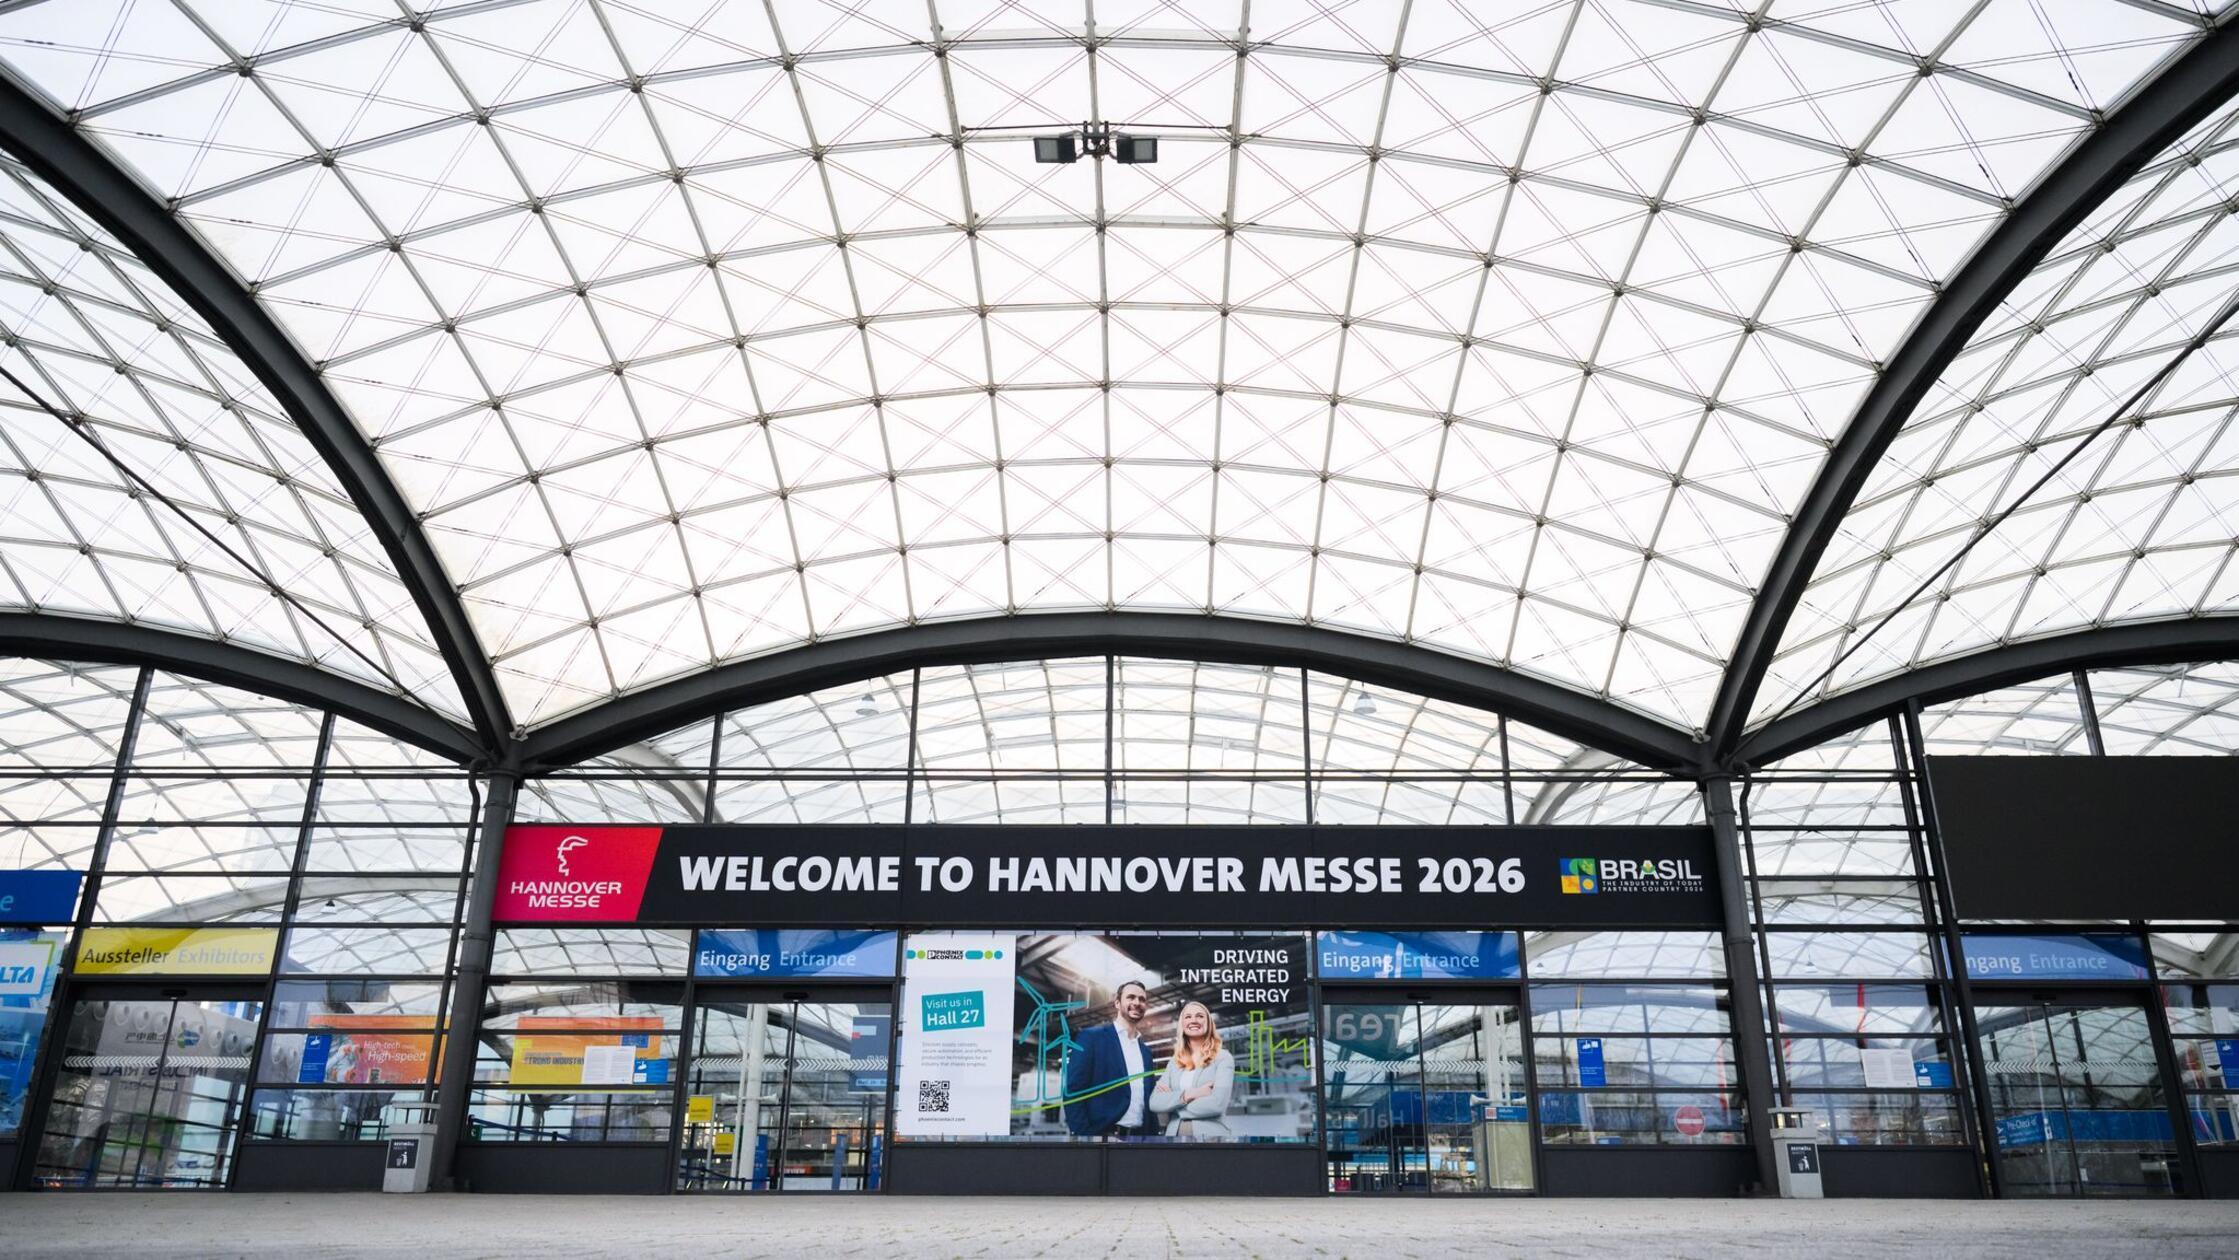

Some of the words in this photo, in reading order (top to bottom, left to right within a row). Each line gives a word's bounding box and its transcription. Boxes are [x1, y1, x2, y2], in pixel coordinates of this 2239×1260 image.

[680, 856, 900, 892] WELCOME
[915, 856, 974, 893] TO
[988, 856, 1246, 893] HANNOVER
[1259, 857, 1402, 893] MESSE
[1418, 857, 1526, 894] 2026
[1599, 859, 1702, 880] BRASIL
[511, 881, 622, 895] HANNOVER
[528, 895, 600, 908] MESSE
[82, 948, 170, 964] Aussteller
[177, 949, 265, 964] Exhibitors
[700, 950, 770, 971] Eingang
[780, 951, 857, 966] Entrance
[1213, 949, 1289, 964] DRIVING
[1322, 952, 1394, 972] Eingang
[1403, 953, 1480, 968] Entrance
[1966, 956, 2022, 974] ngang
[2029, 953, 2108, 969] Entrance
[1180, 969, 1289, 983] INTEGRATED
[926, 999, 947, 1009] Visit
[949, 999, 960, 1007] us
[963, 997, 972, 1006] in
[1221, 988, 1290, 1003] ENERGY
[926, 1010, 956, 1026] Hall
[960, 1009, 979, 1023] 27
[363, 1040, 400, 1050] High-tech
[367, 1051, 426, 1064] High-speed
